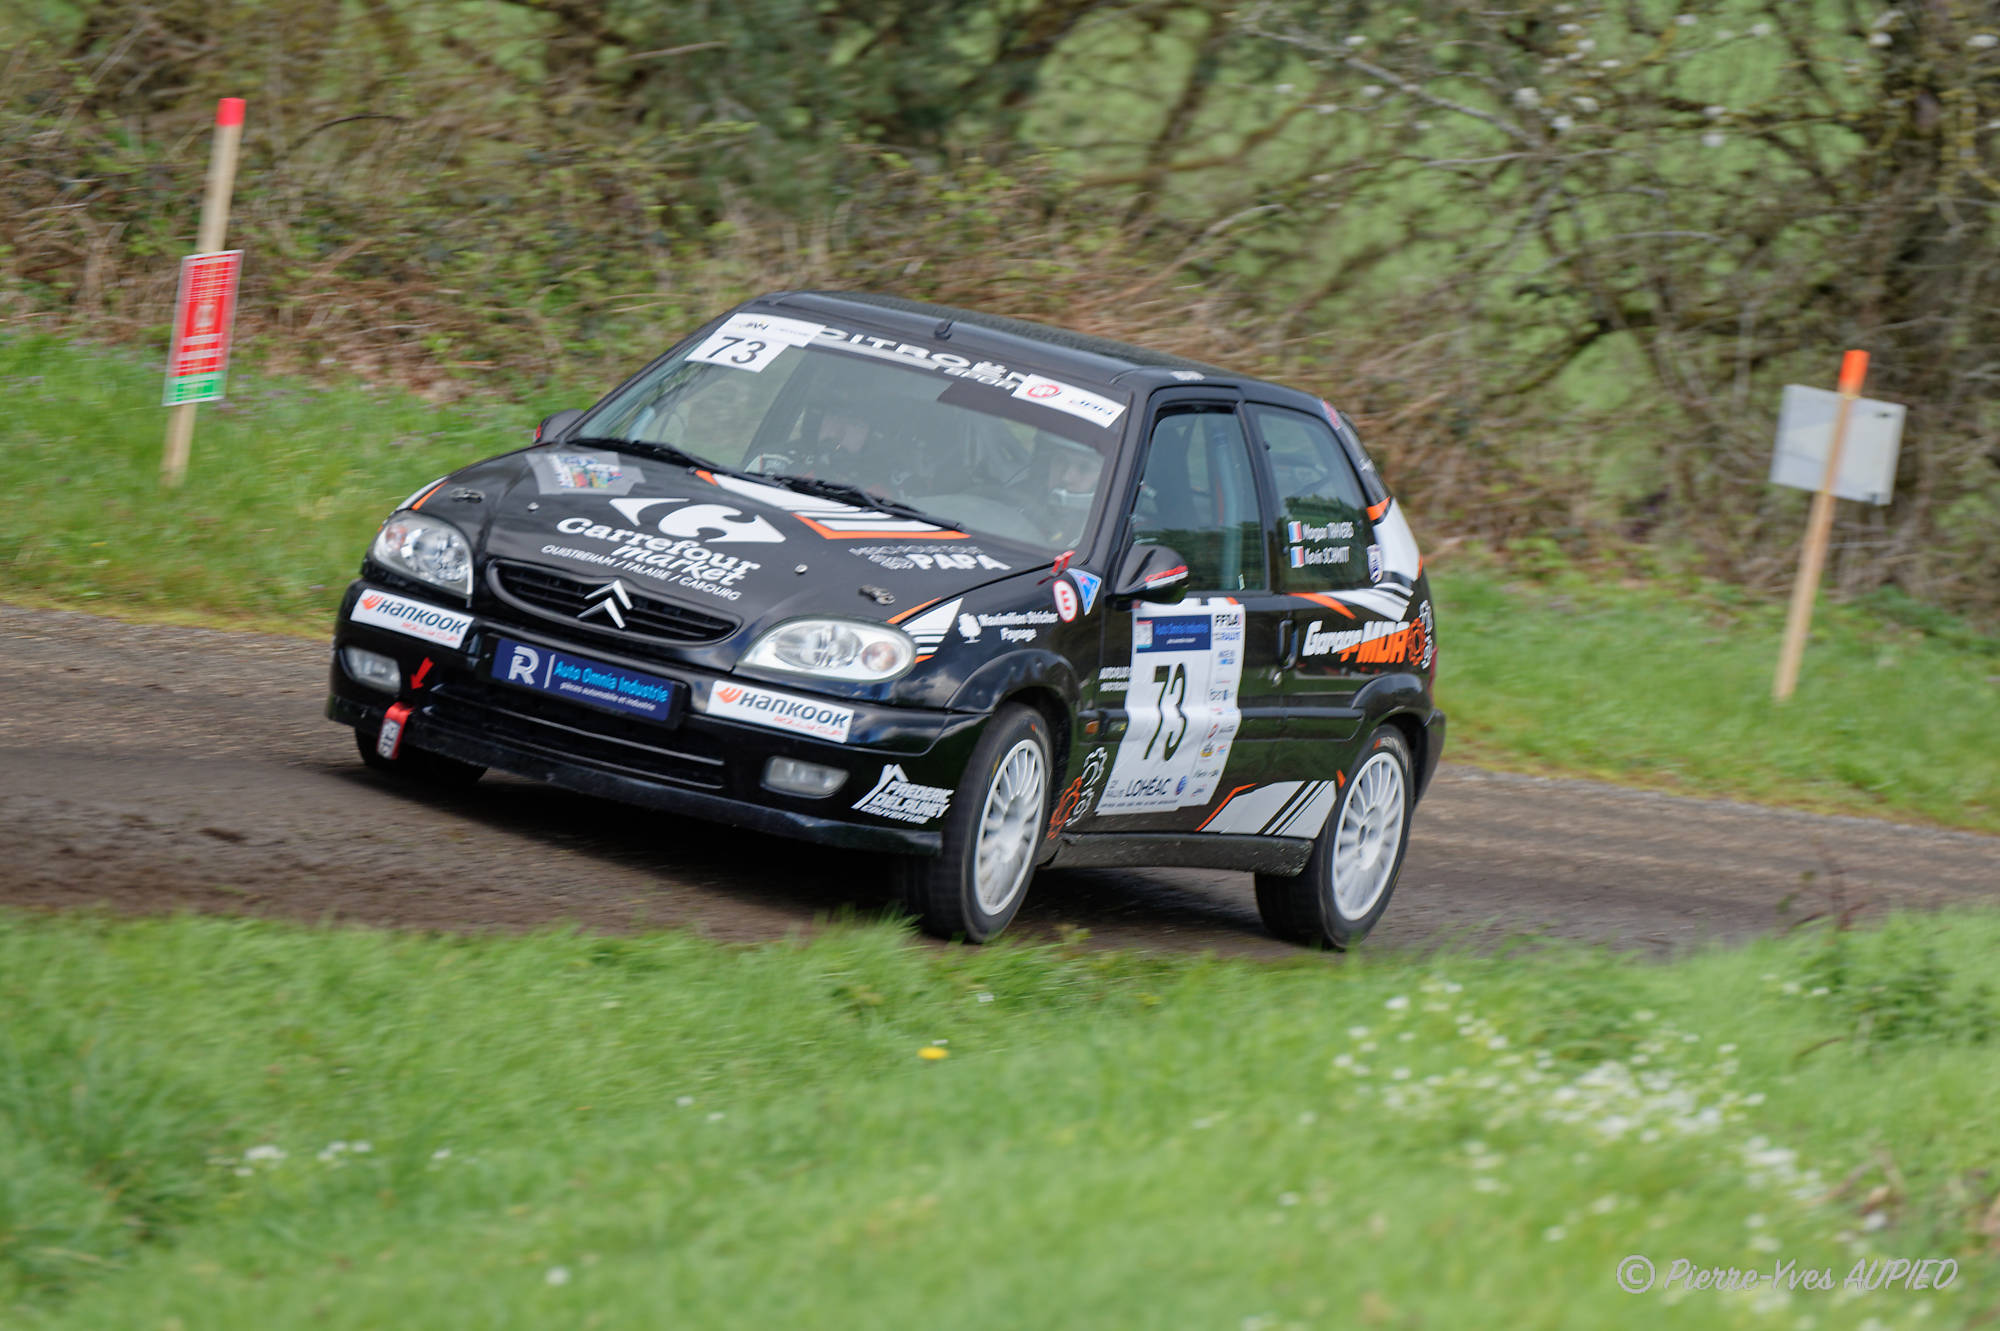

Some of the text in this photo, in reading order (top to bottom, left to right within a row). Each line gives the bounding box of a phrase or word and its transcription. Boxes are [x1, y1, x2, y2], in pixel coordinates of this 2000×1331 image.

[706, 336, 767, 364] 73
[556, 517, 761, 571] Carrefour
[611, 544, 748, 586] market
[906, 553, 1012, 570] PAPA
[541, 544, 616, 567] OUISTREHAM
[623, 560, 673, 581] FALAISE
[679, 577, 742, 601] CABOURG
[553, 661, 669, 703] Auto Omnia Industrie
[1143, 663, 1187, 761] 73
